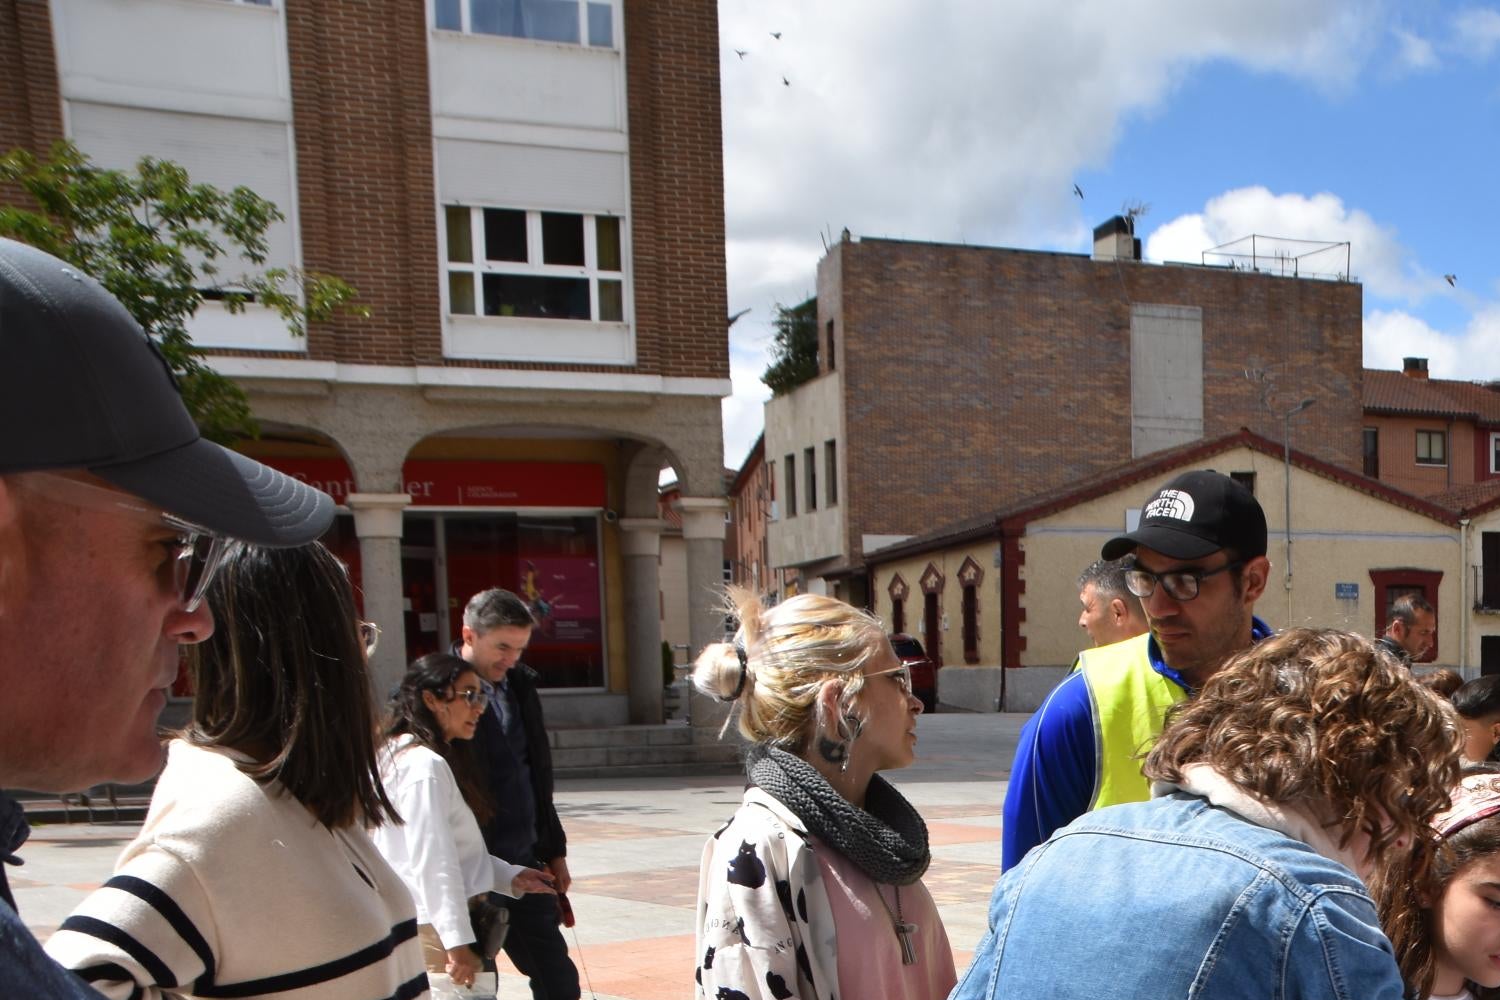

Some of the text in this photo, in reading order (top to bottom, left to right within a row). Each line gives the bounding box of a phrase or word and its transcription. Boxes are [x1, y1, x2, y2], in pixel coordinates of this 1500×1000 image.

[1160, 489, 1179, 499] THE
[1145, 498, 1175, 513] NORTH
[1146, 507, 1171, 519] FACE
